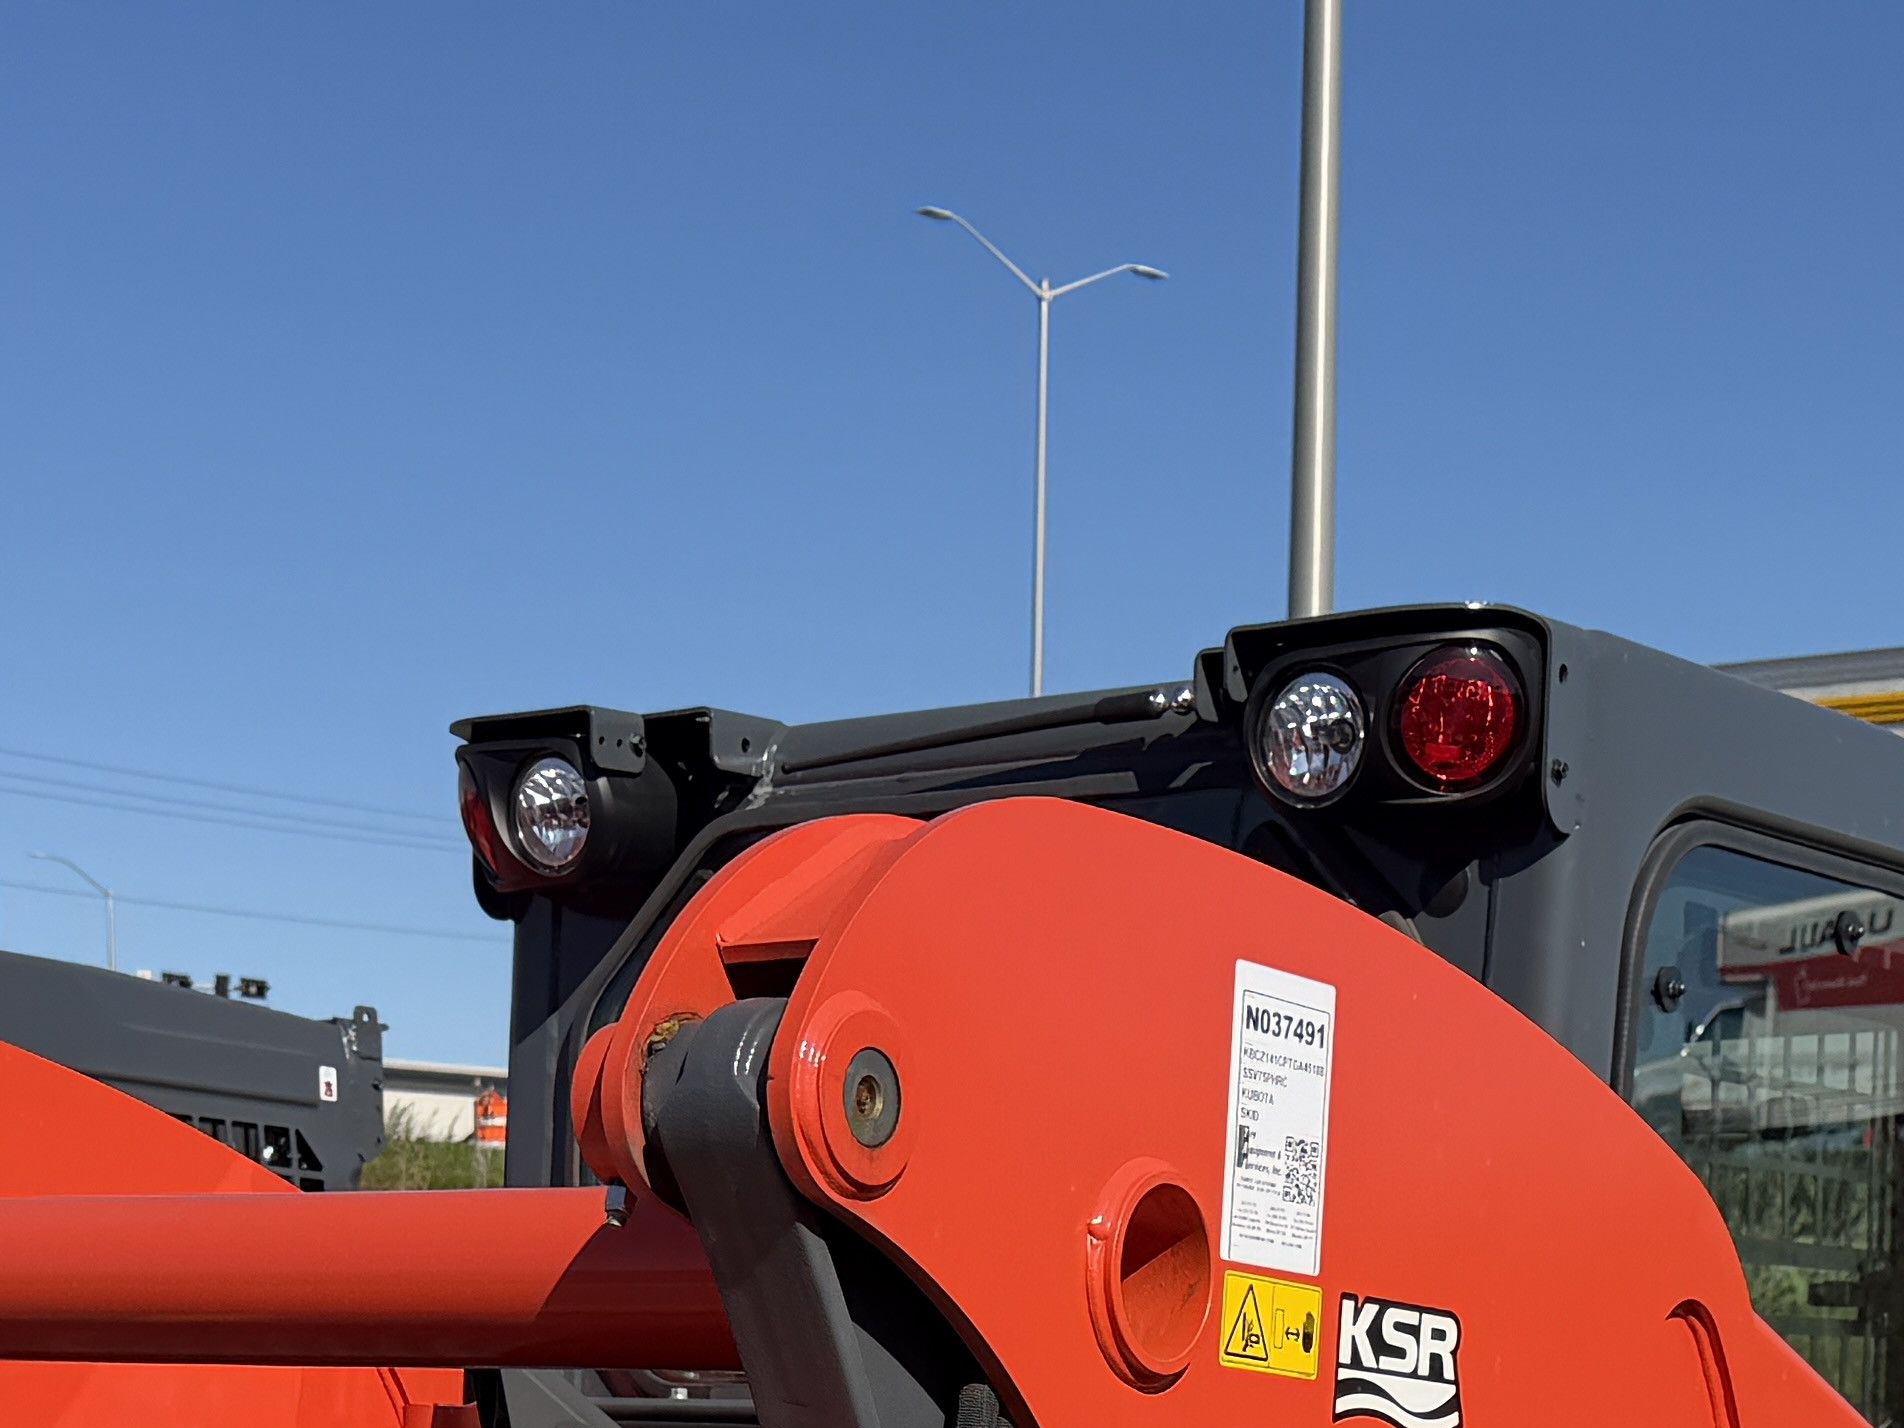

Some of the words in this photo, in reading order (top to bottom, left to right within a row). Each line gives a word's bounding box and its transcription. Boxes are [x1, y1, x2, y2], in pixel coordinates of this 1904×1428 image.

[1246, 1005, 1325, 1049] N037491
[1242, 1088, 1274, 1106] KUBOTA
[1241, 1107, 1259, 1122] SKID
[1338, 1299, 1458, 1381] KSR
